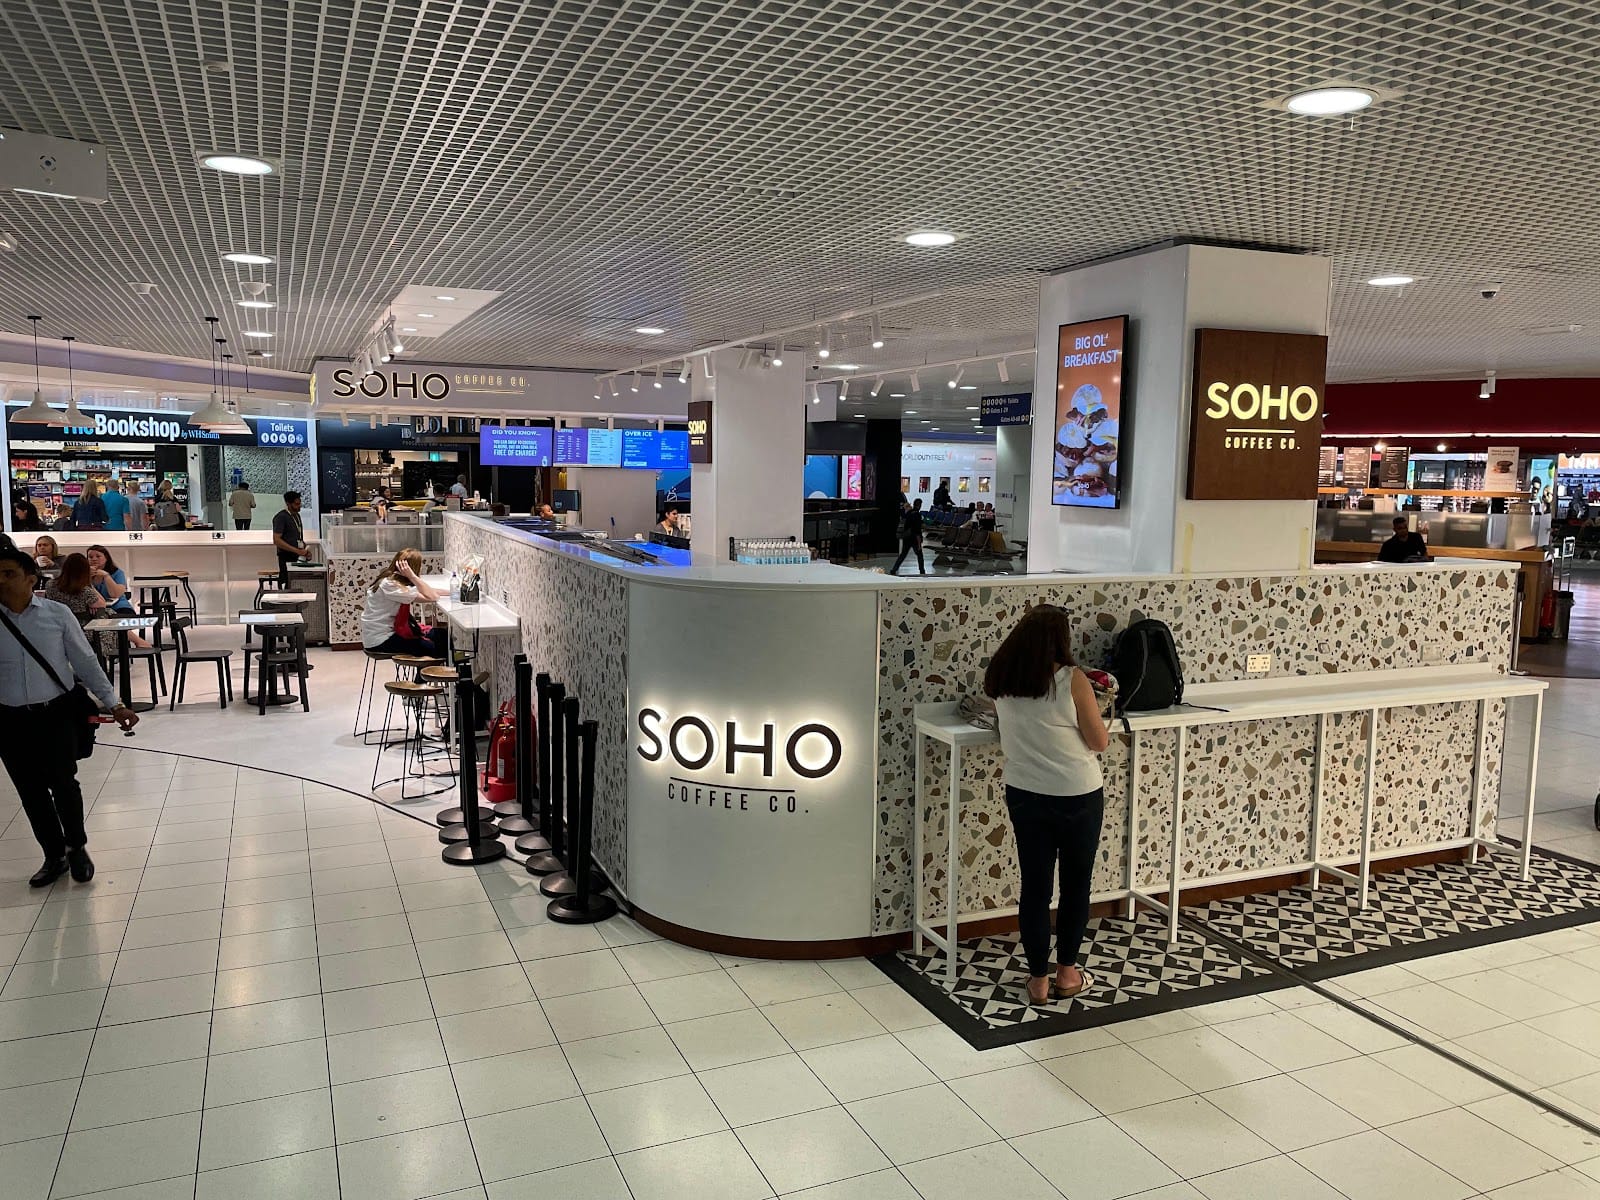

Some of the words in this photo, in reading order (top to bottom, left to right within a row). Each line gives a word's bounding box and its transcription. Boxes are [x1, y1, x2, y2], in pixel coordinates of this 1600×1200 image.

[1075, 336, 1091, 350] BIG
[1064, 349, 1119, 368] BREAKFAST
[332, 369, 450, 400] SOHO
[1205, 382, 1318, 421] SOHO
[95, 413, 181, 441] Bookshop
[181, 430, 188, 439] by
[270, 422, 295, 433] Toilets
[688, 420, 707, 435] SOHO
[1224, 436, 1274, 450] COFFEE
[1280, 437, 1301, 450] CO.
[636, 707, 842, 779] SOHO
[668, 783, 749, 811] COFFEE
[769, 795, 809, 814] CO.
